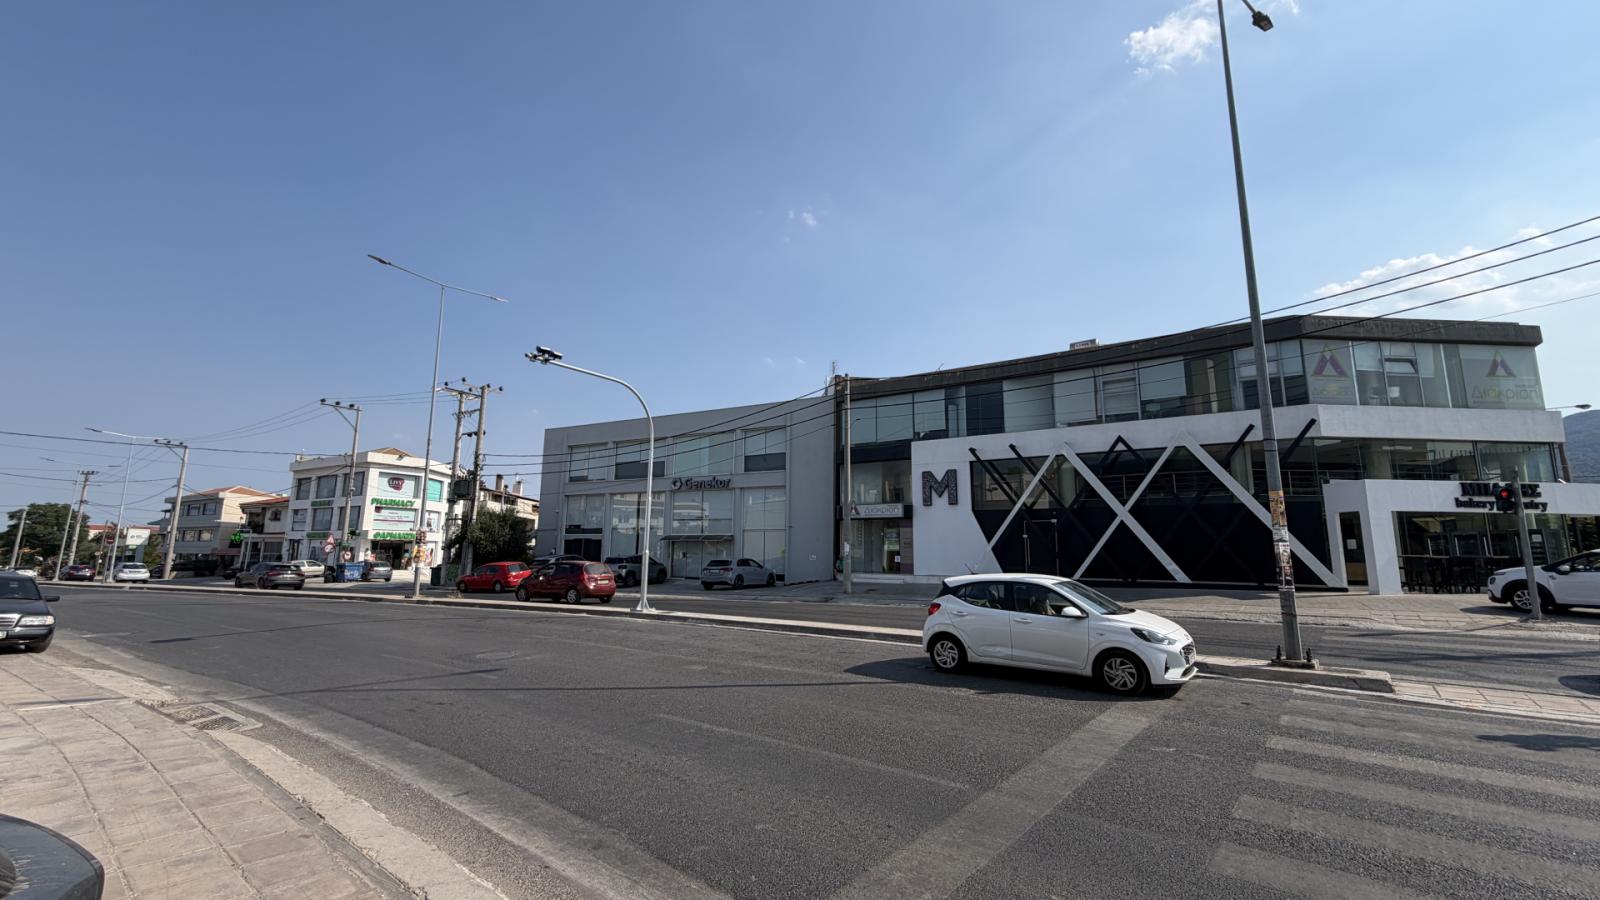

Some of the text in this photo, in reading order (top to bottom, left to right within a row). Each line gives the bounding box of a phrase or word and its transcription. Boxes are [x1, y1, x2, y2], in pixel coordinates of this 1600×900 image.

[685, 476, 731, 489] Genekor
[922, 469, 958, 507] M
[371, 497, 416, 507] PHARMACY
[1454, 497, 1496, 511] bakery
